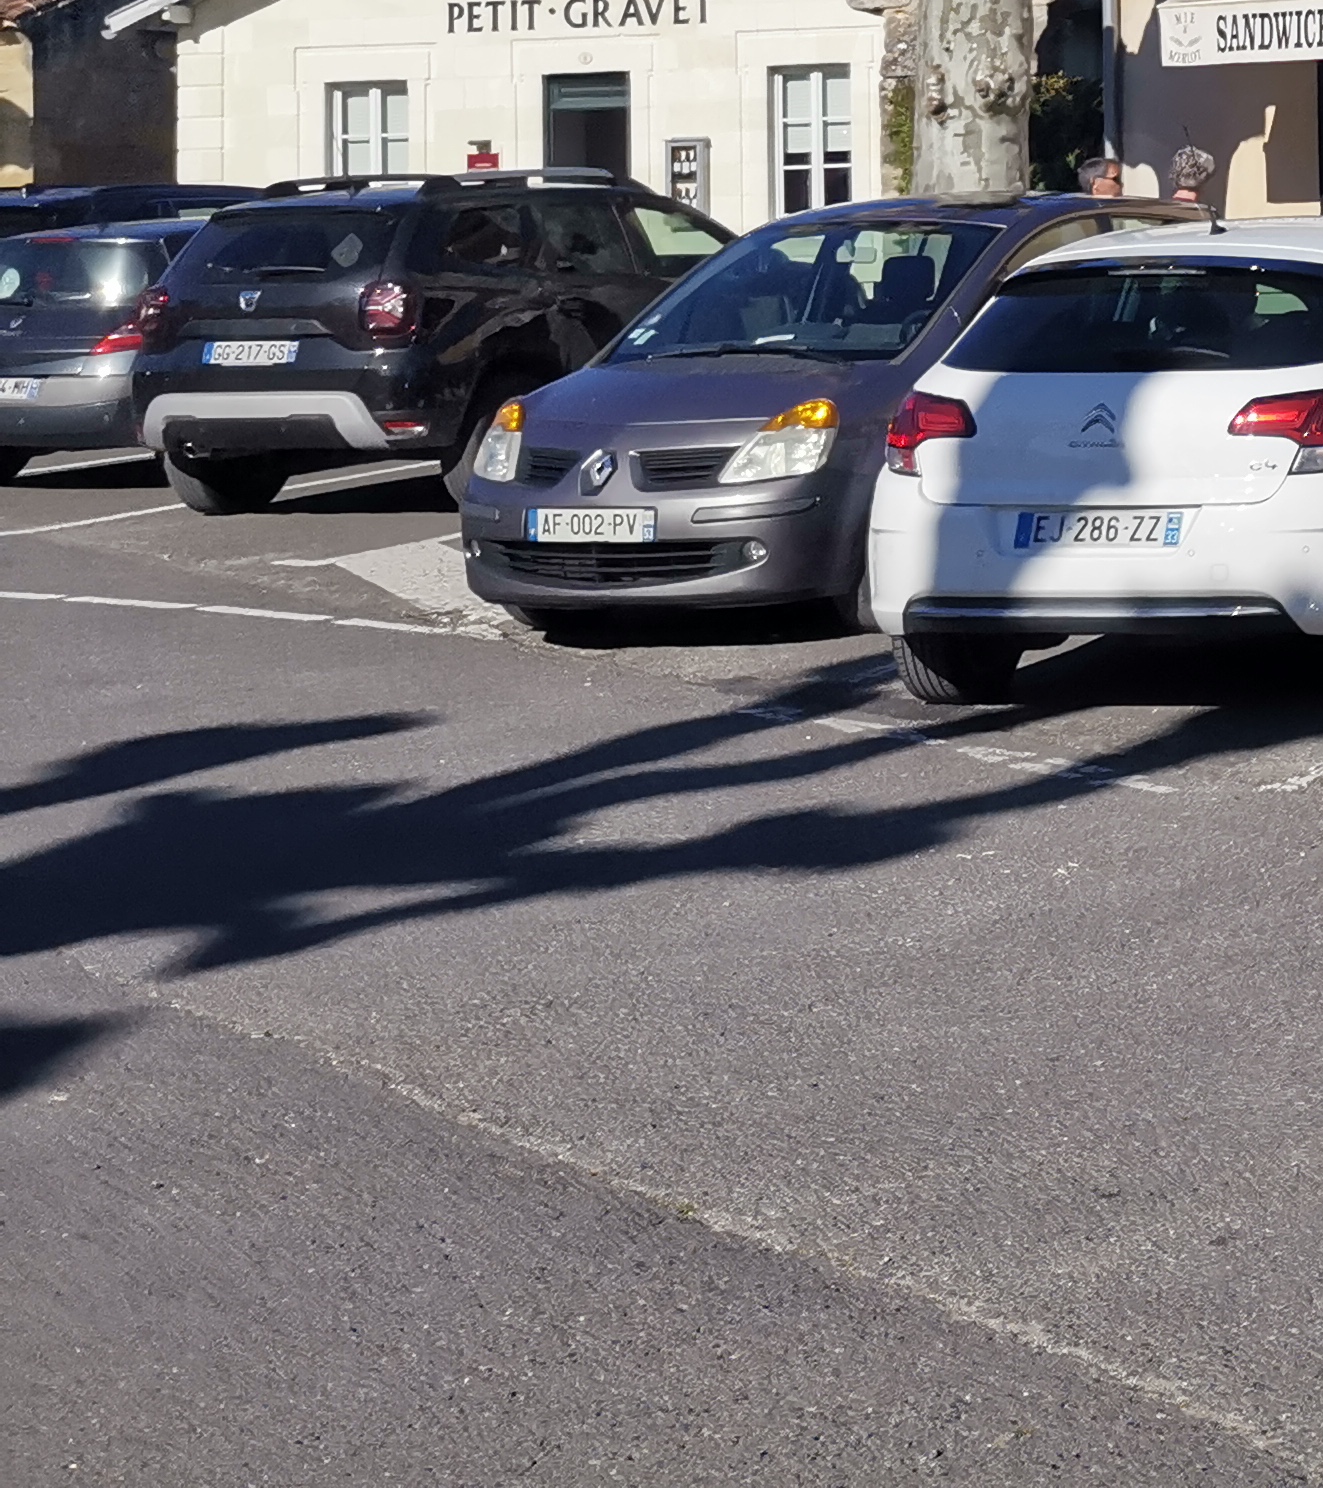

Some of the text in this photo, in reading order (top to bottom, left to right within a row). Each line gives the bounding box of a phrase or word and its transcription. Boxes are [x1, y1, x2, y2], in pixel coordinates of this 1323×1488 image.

[213, 344, 287, 361] GG-217-GS
[542, 513, 637, 536] AF-002-PV
[1033, 515, 1161, 543] EJ-286-ZZ
[1165, 531, 1179, 544] 33
